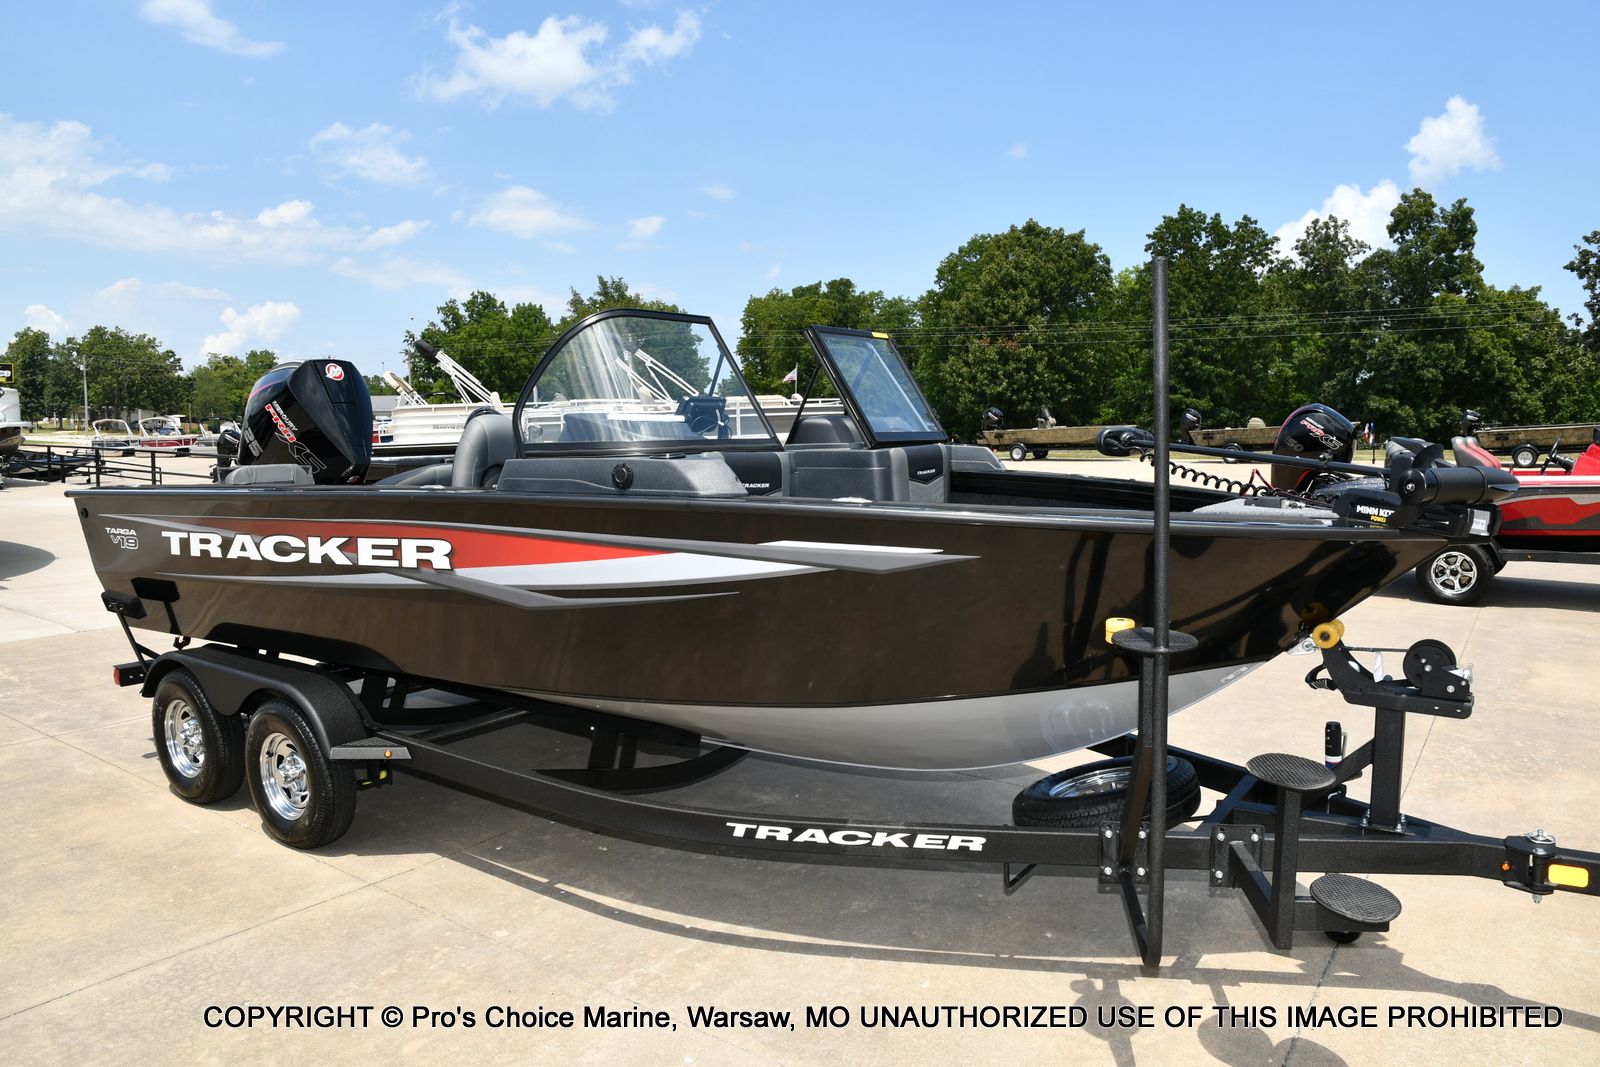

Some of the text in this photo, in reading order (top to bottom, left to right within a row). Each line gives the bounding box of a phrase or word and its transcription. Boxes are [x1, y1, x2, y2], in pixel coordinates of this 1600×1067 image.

[265, 403, 296, 442] PRO
[271, 400, 298, 431] MERCURY
[1356, 505, 1379, 516] MINN
[104, 527, 137, 536] TARGA
[110, 534, 139, 550] V19
[161, 530, 453, 570] TRACKER
[725, 821, 988, 852] TRACKER
